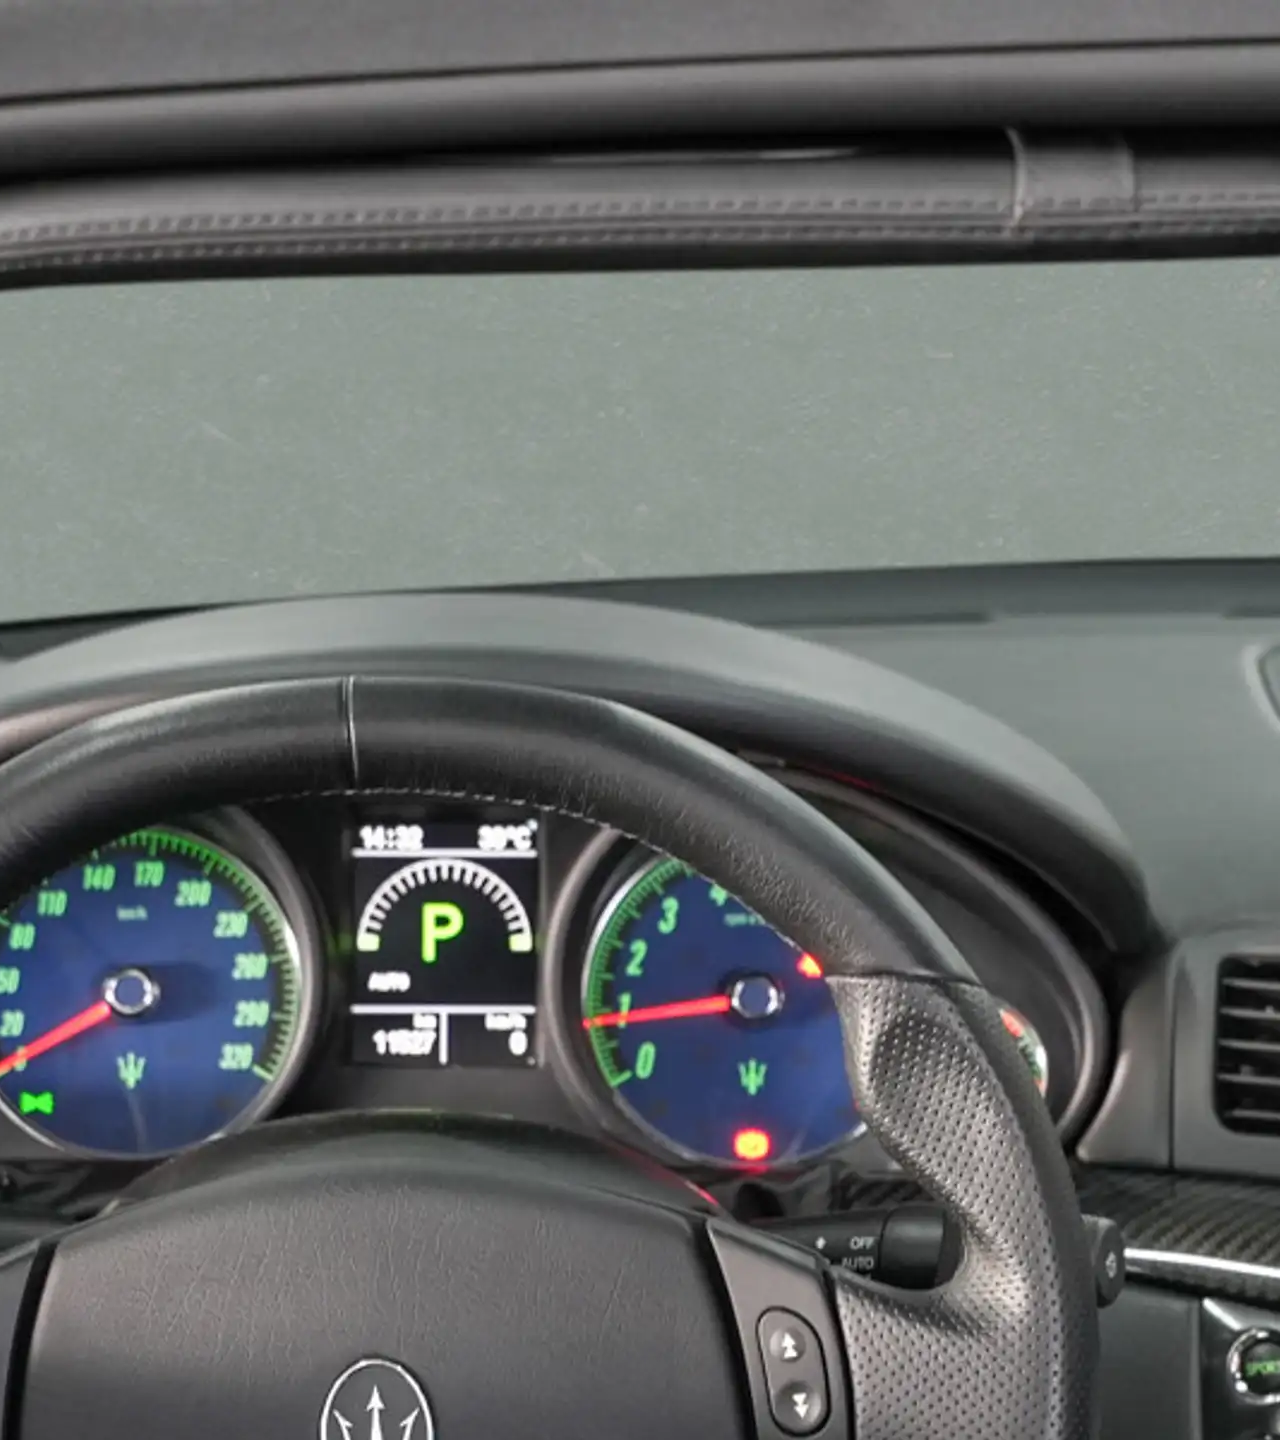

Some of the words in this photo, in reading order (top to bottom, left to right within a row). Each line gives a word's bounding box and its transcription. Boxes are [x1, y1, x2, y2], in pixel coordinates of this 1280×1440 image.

[83, 865, 116, 891] 140
[134, 861, 164, 886] 170
[38, 891, 67, 915] 110
[175, 880, 211, 906] 200
[214, 911, 249, 938] 230
[658, 897, 679, 934] 3
[9, 924, 35, 949] 80
[422, 902, 464, 964] P
[232, 954, 268, 980] 260
[627, 940, 648, 976] 2
[234, 1001, 269, 1027] 290
[617, 992, 632, 1028] 1
[0, 1011, 24, 1036] 20
[509, 1029, 528, 1055] 0
[219, 1045, 253, 1070] 320
[635, 1041, 656, 1079] 0
[850, 1236, 876, 1250] OFF
